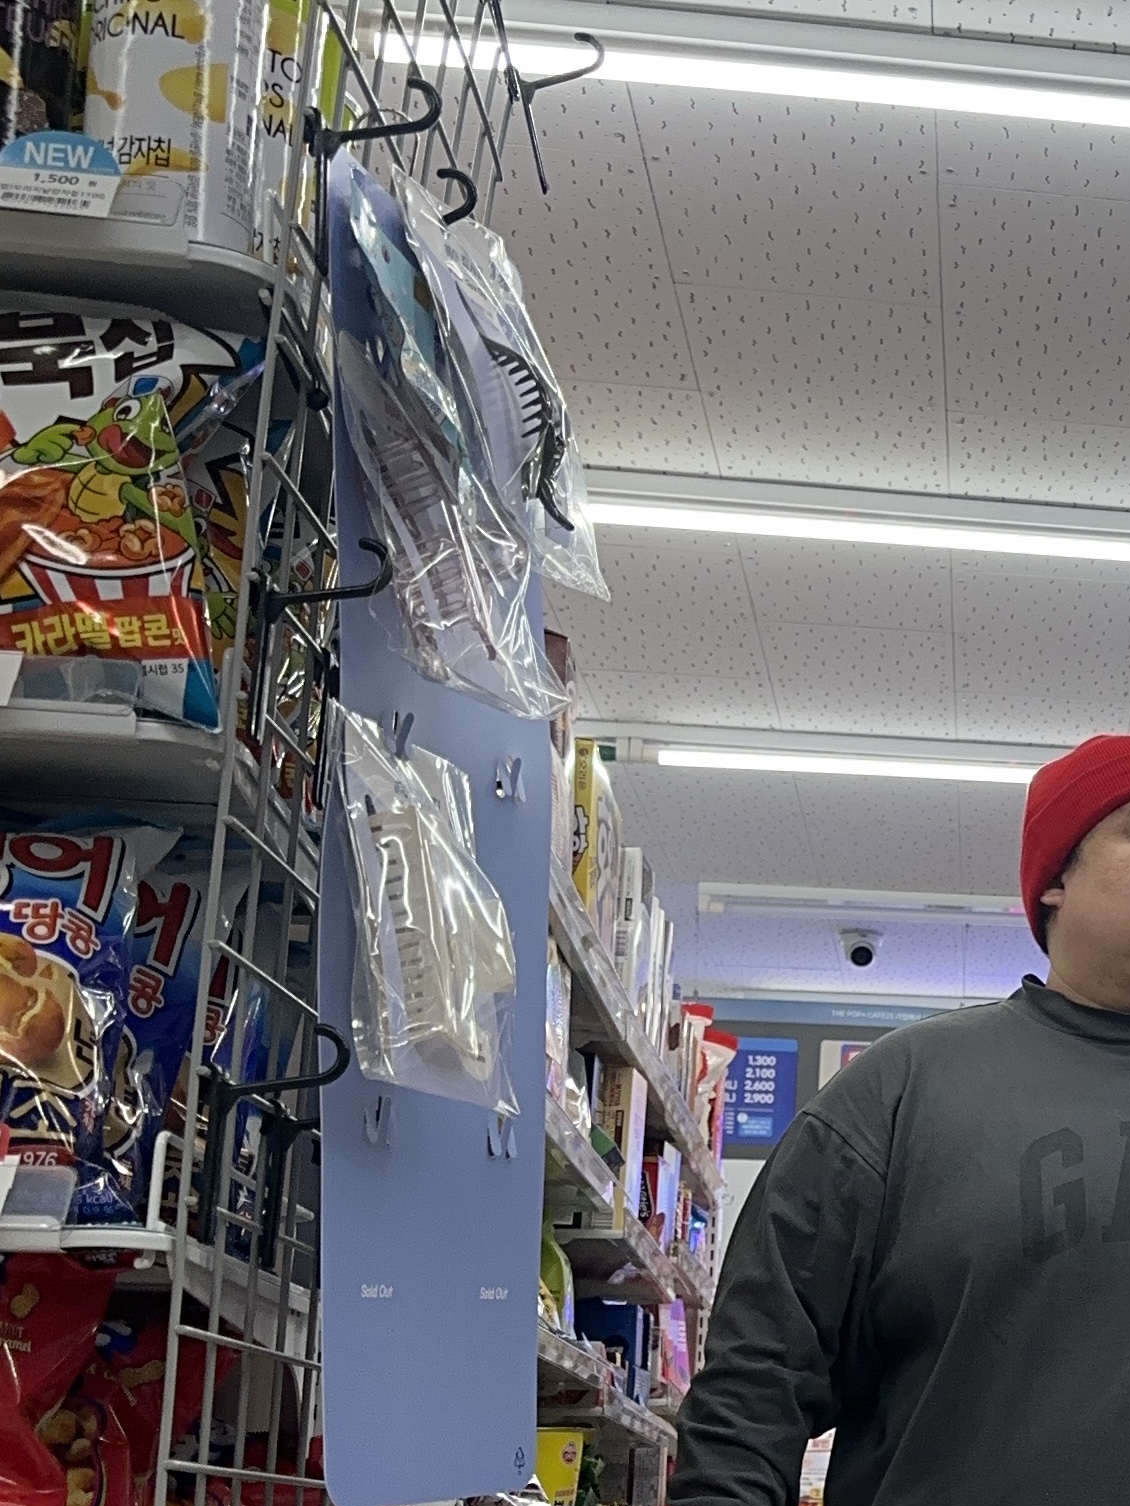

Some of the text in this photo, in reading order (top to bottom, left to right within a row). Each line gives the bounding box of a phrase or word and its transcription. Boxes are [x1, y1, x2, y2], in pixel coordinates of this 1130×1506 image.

[23, 141, 95, 170] NEW
[10, 898, 100, 960] 땅콩
[360, 1283, 394, 1299] Sold Out
[479, 1286, 509, 1300] Sold Out
